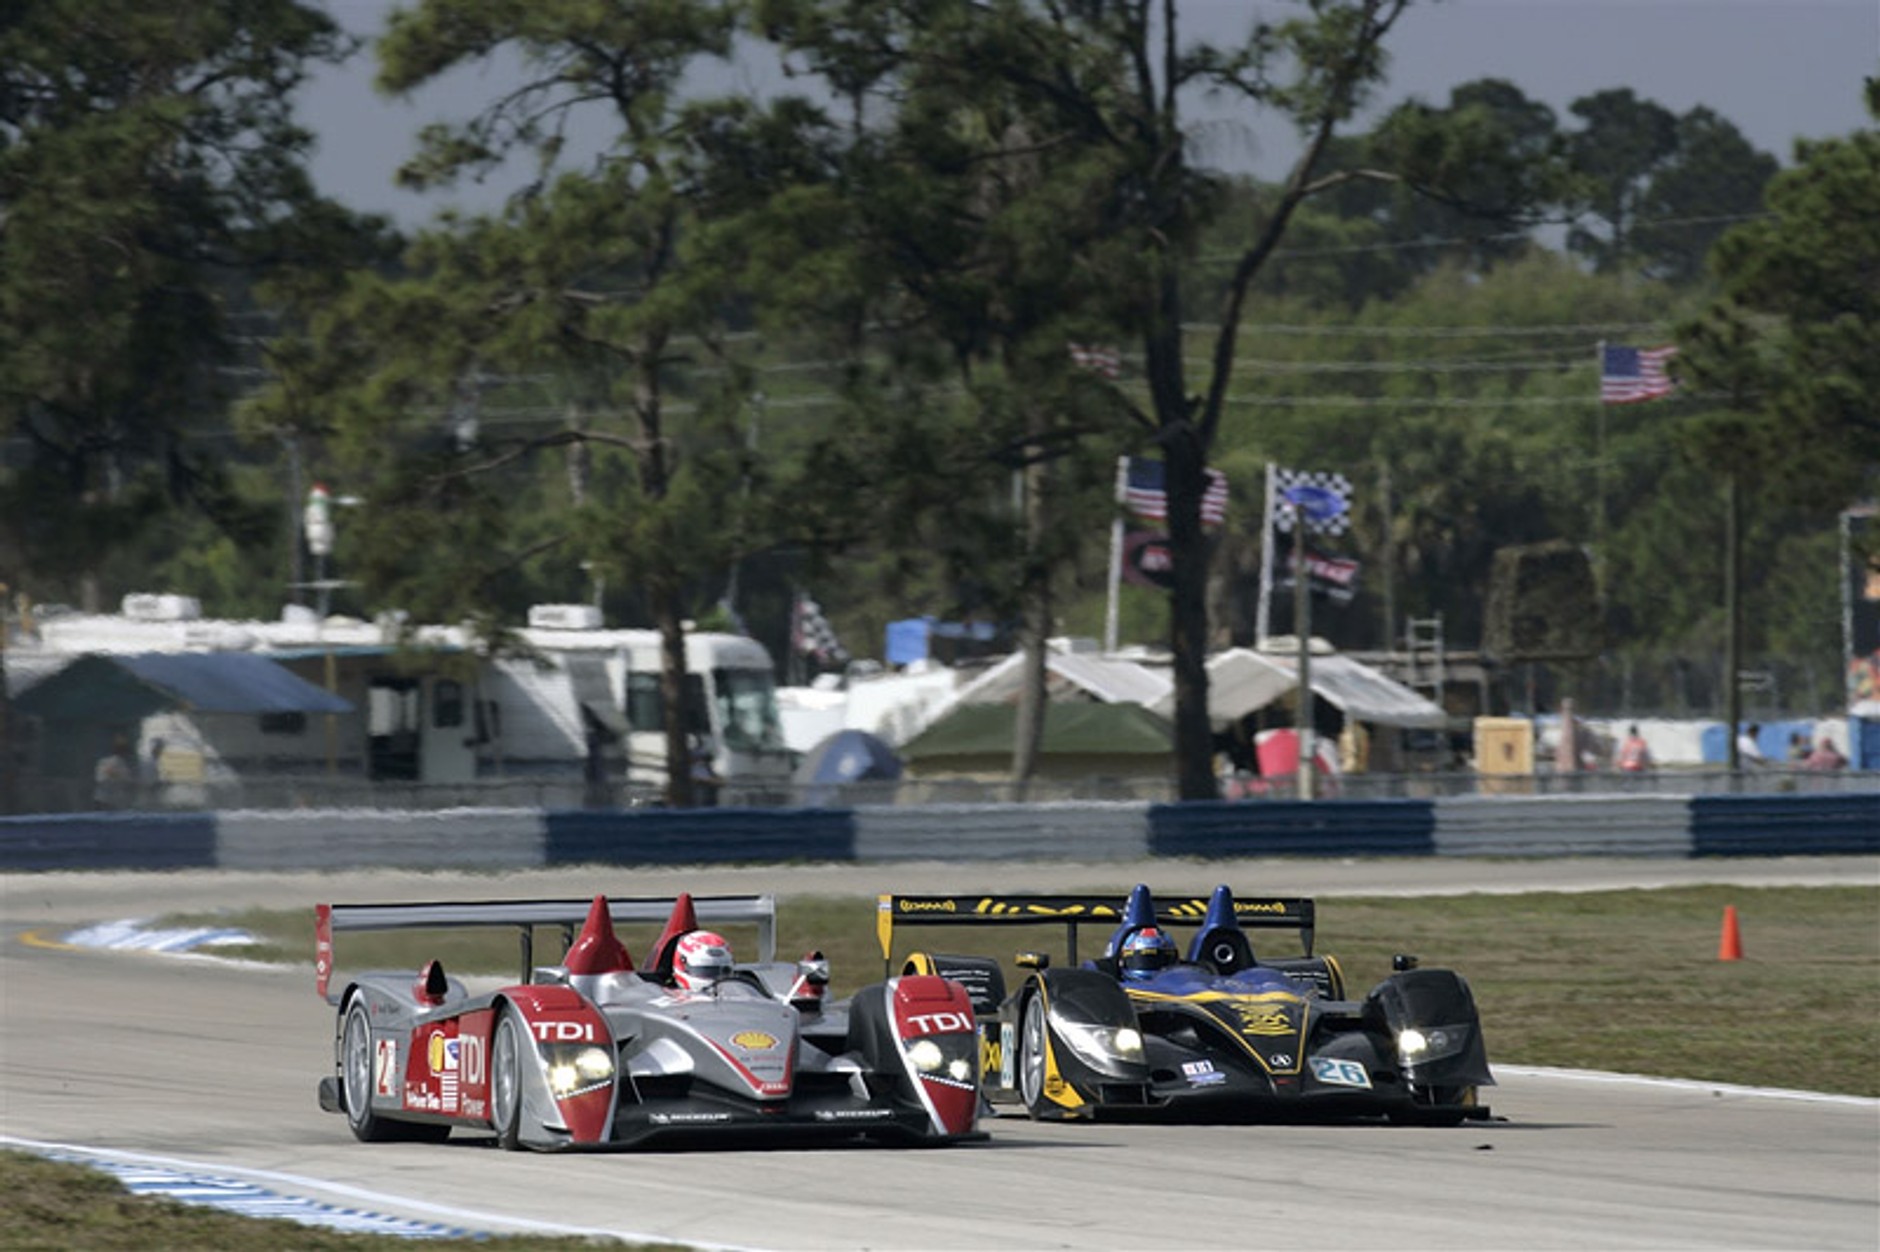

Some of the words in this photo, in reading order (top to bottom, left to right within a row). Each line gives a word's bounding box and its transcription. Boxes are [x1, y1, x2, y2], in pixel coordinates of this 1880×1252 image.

[531, 1021, 594, 1041] TDI
[906, 1012, 972, 1033] TDI
[459, 1033, 486, 1085] TDI
[1311, 1059, 1367, 1085] 26
